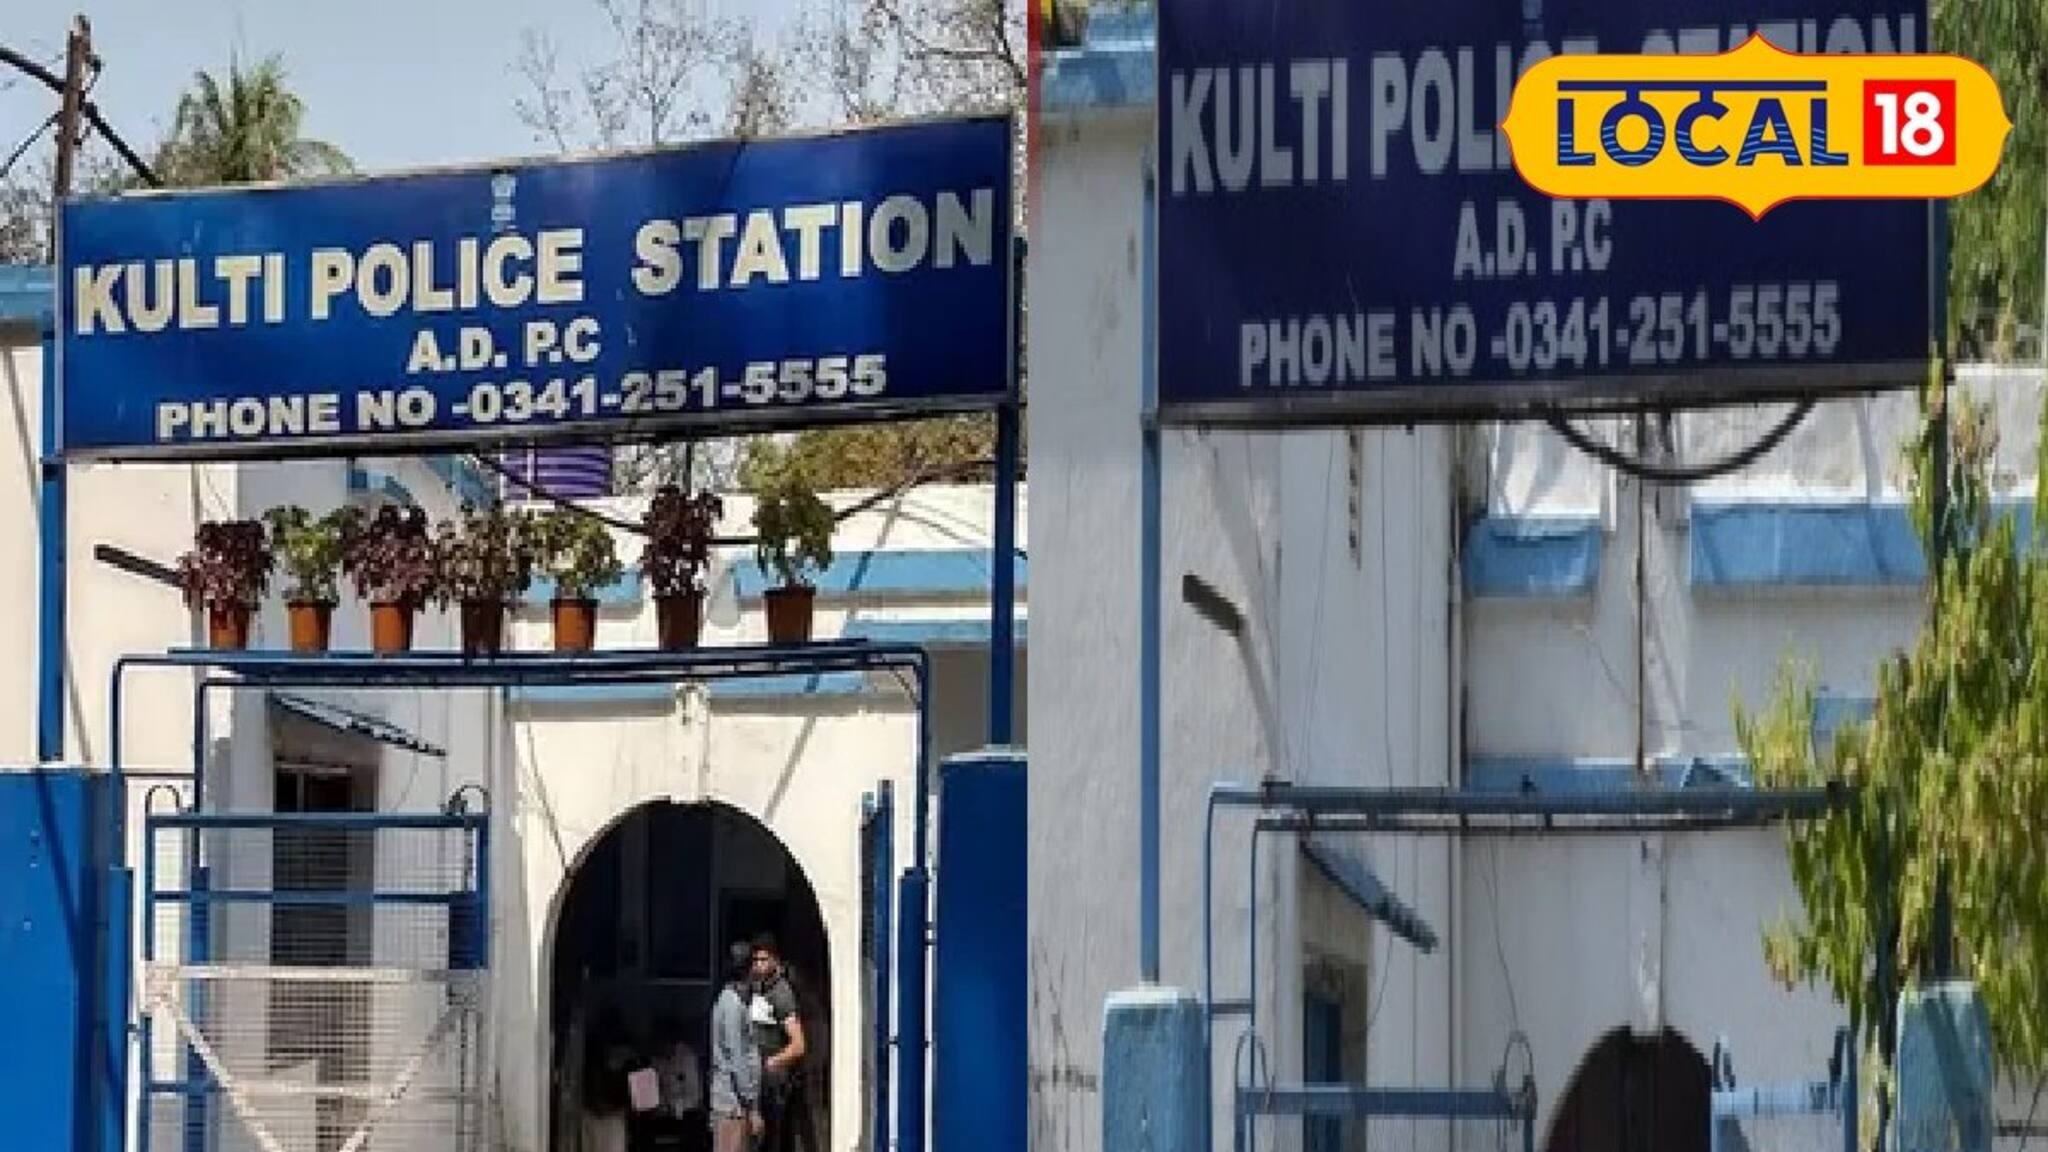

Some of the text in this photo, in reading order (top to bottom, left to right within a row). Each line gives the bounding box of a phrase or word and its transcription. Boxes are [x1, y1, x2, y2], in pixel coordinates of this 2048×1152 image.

[1170, 36, 1598, 195] KULTI POLI
[74, 188, 994, 335] KULTI POLICE STATION
[1454, 199, 1613, 280] A.D. P.C
[406, 317, 601, 373] A.D. P.C
[1241, 311, 1396, 387] PHONE
[1411, 302, 1476, 378] NO
[156, 354, 888, 438] PHONE NO -0341-251-5555
